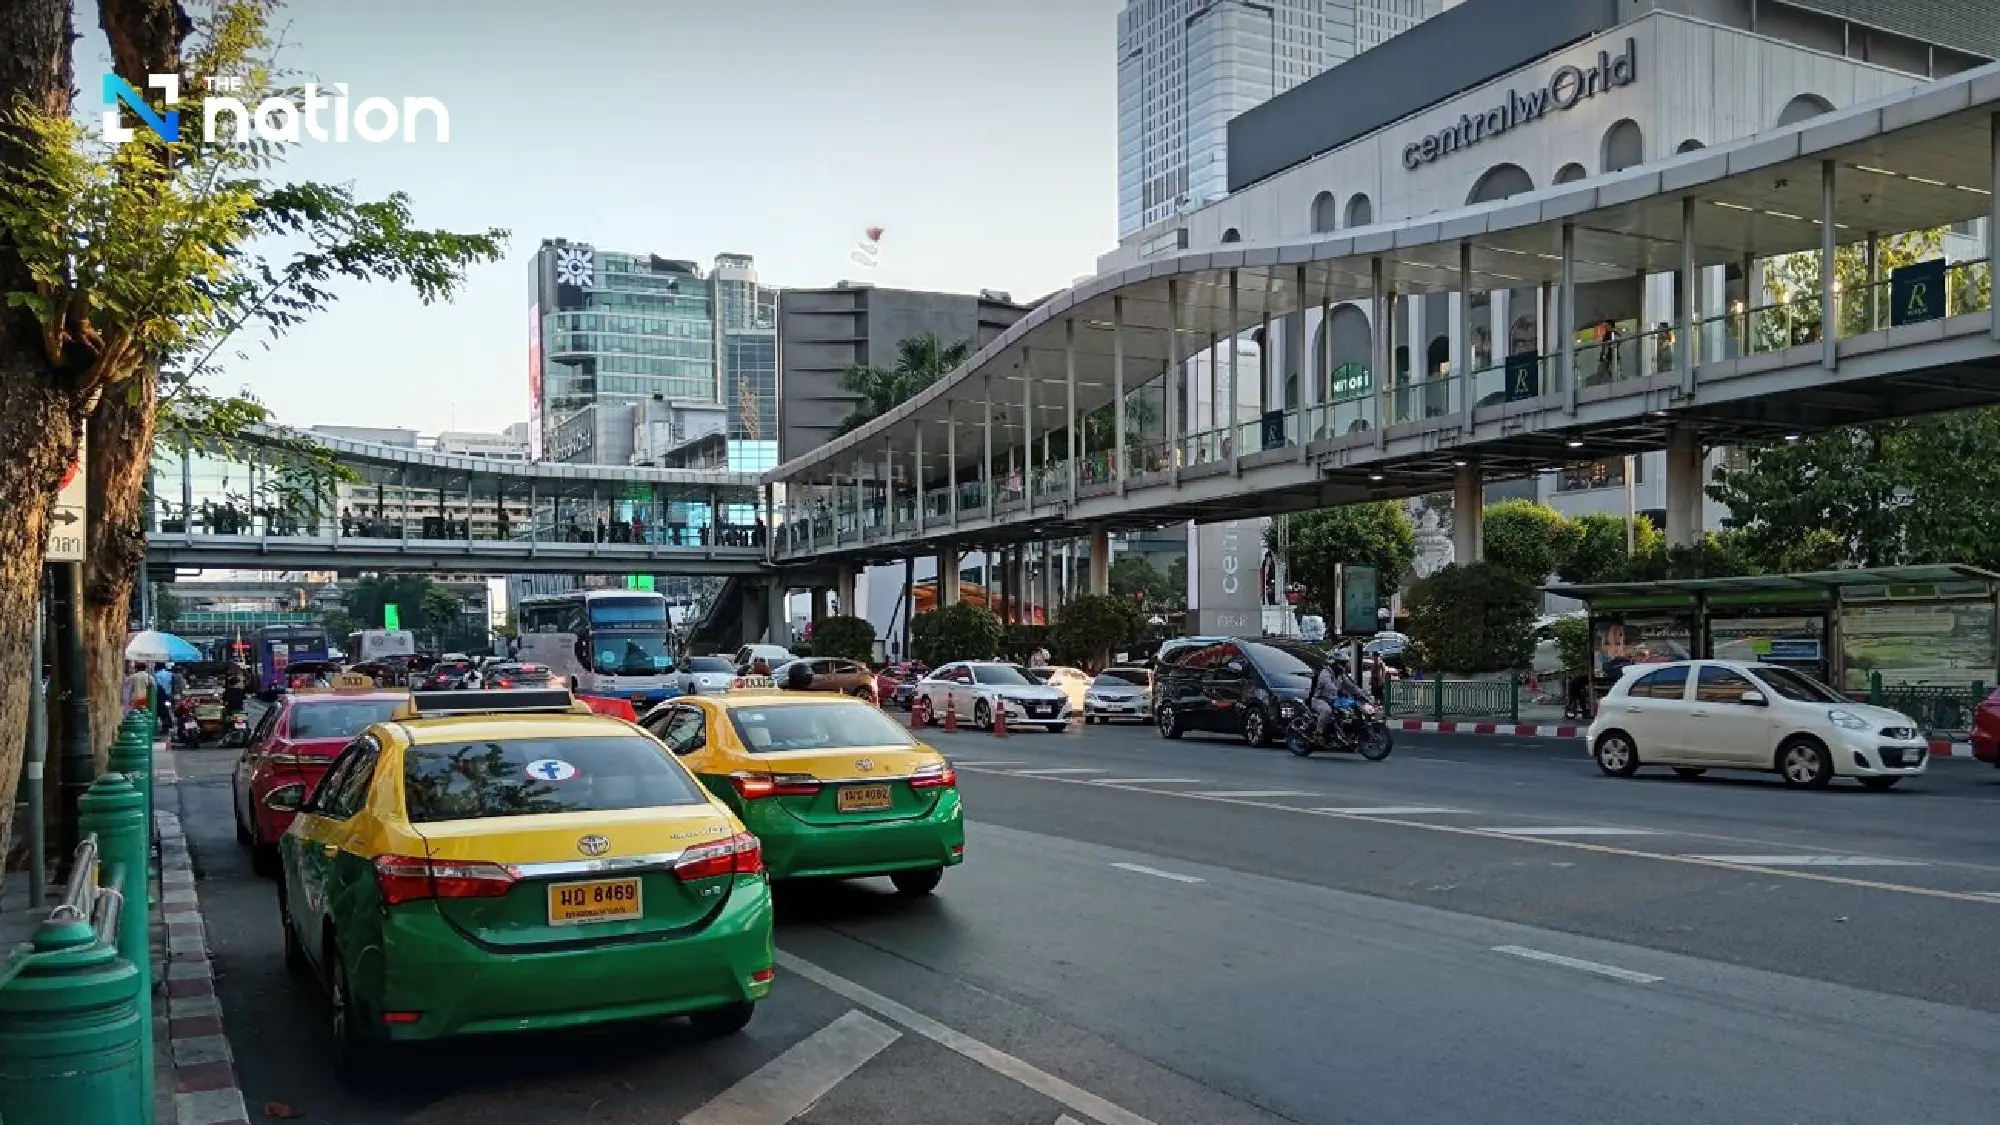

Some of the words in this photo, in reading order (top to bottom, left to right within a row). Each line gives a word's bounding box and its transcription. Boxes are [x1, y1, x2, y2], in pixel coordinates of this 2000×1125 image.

[341, 676, 363, 686] TAXI
[745, 677, 766, 689] TAXI
[594, 883, 635, 904] 8469
